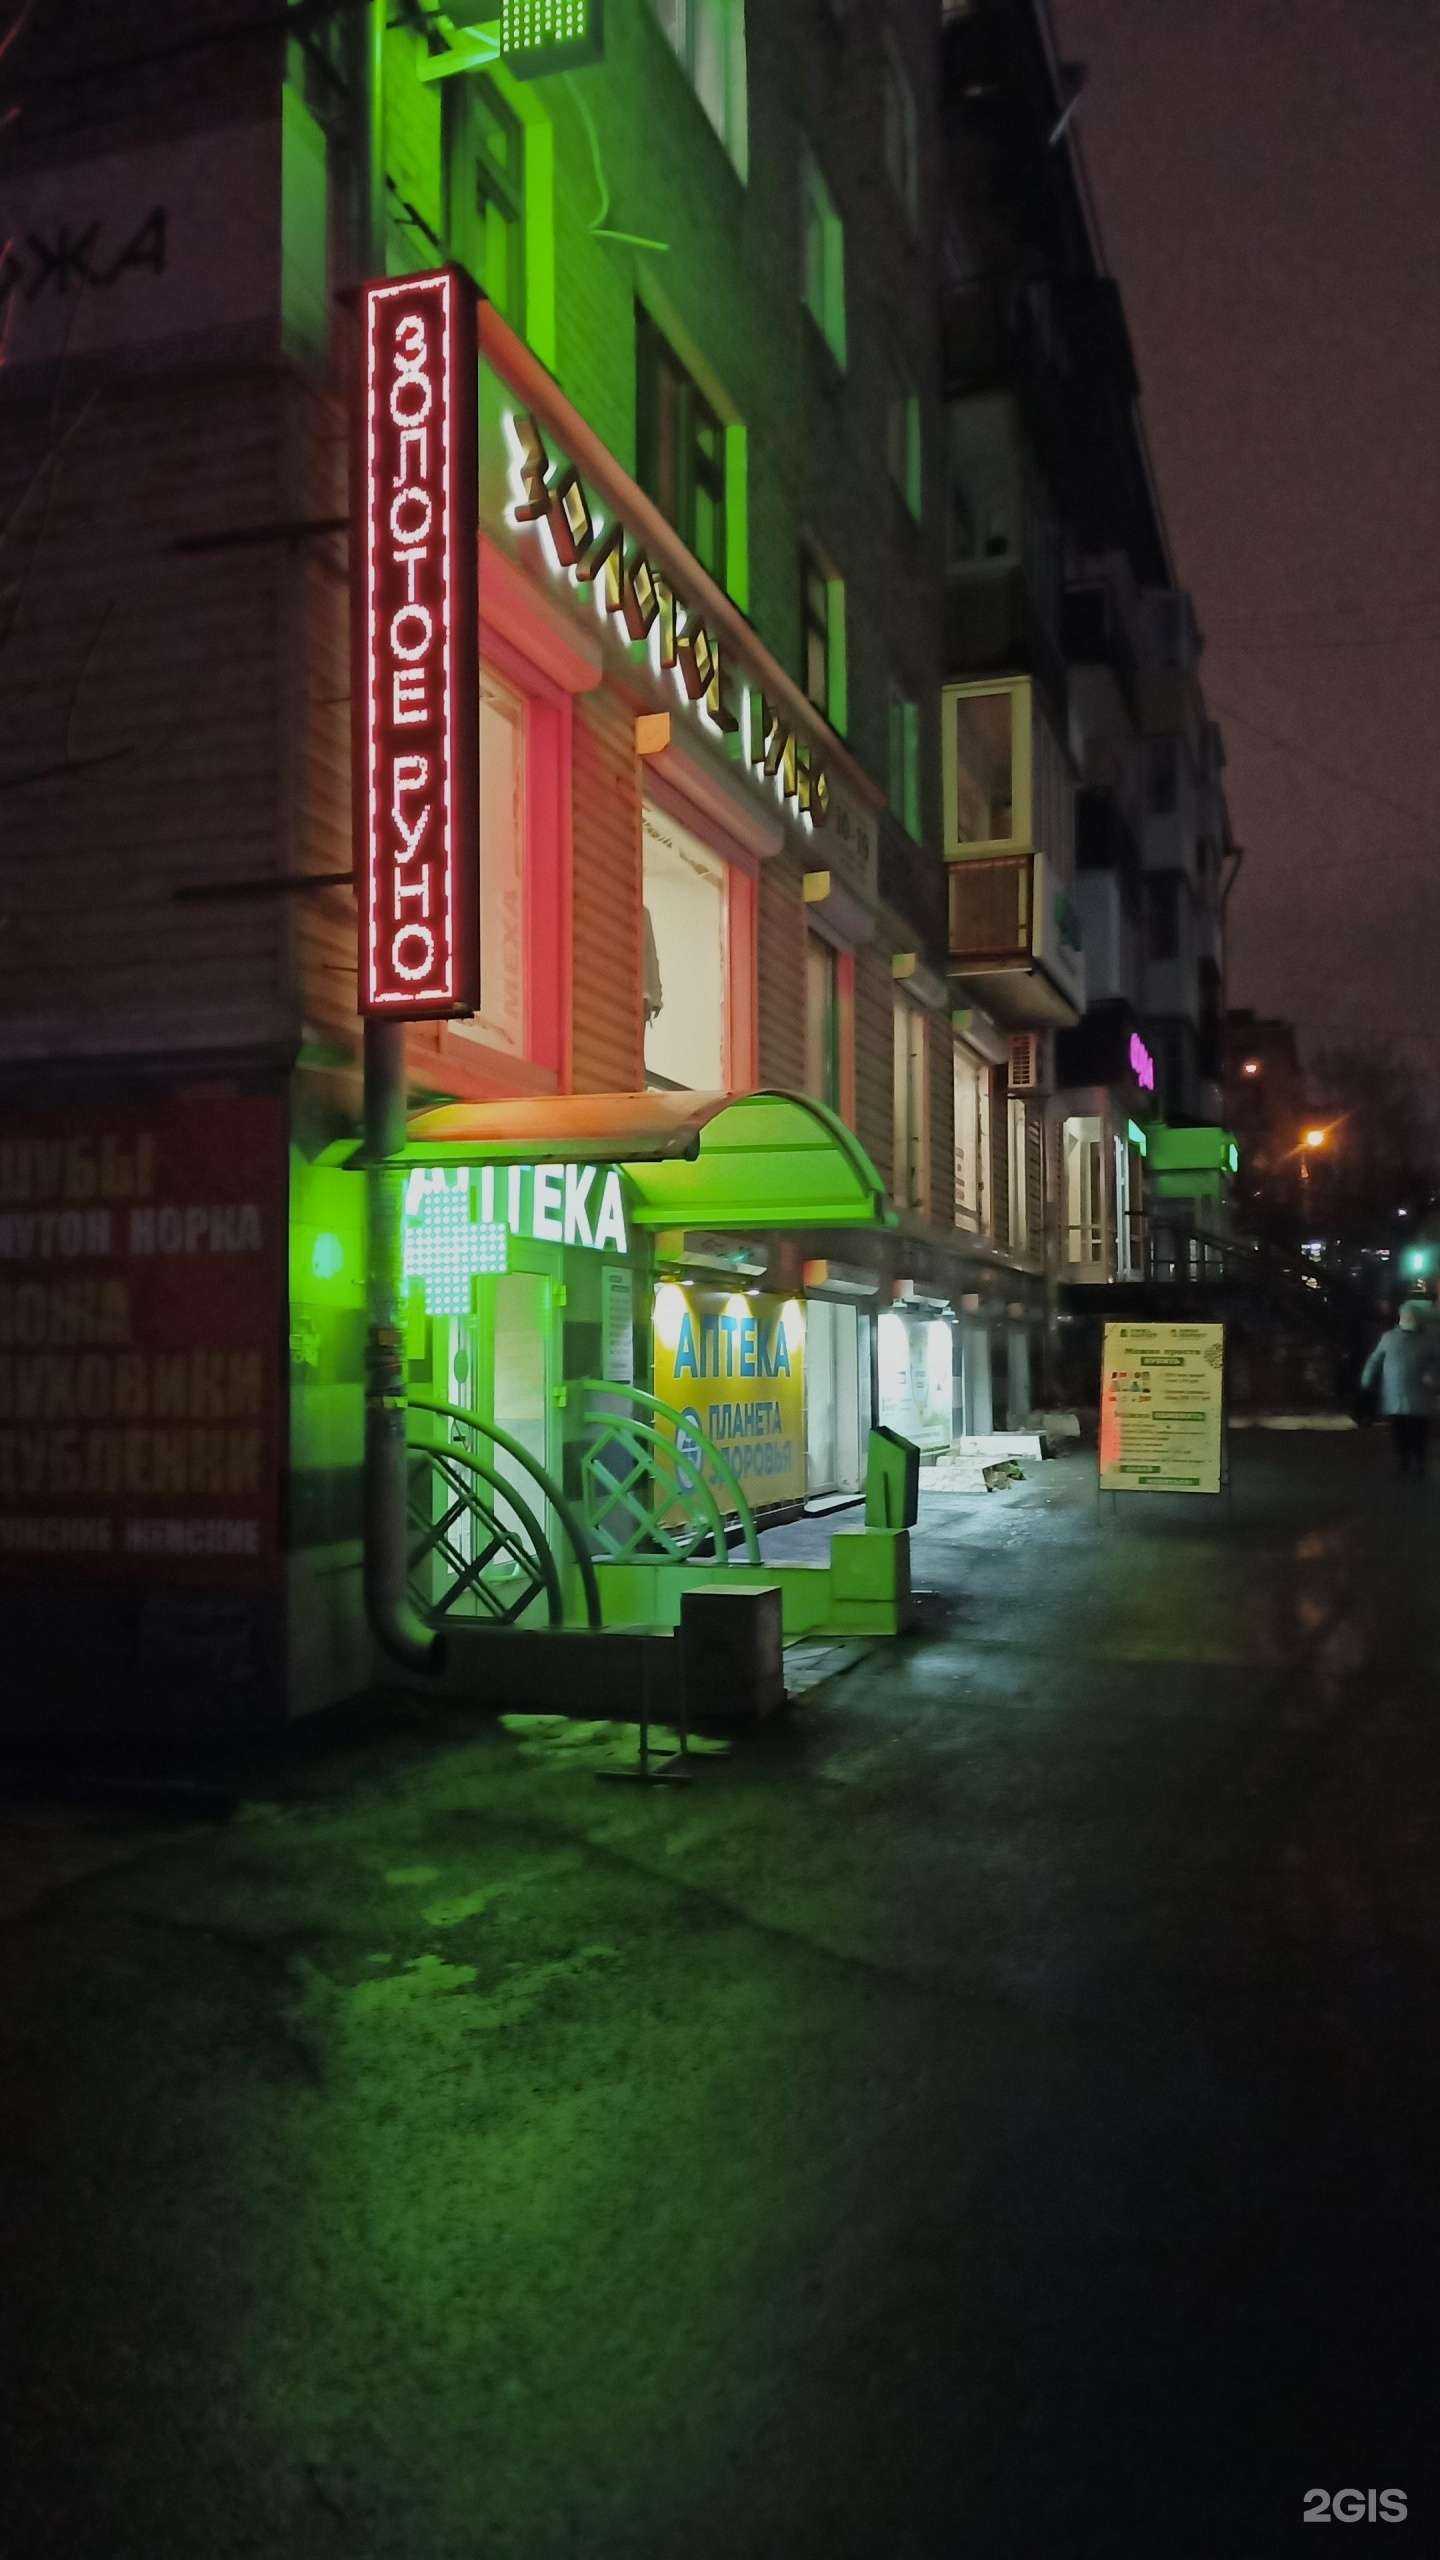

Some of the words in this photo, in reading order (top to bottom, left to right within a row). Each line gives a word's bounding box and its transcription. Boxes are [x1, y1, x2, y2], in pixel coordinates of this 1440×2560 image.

[390, 315, 433, 725] ЗОЛОТОЕ
[391, 755, 434, 981] РУНО
[129, 1204, 263, 1255] НОРКА
[673, 1313, 791, 1378] АПТЕКА
[709, 1402, 783, 1440] ПЛАНЕТА
